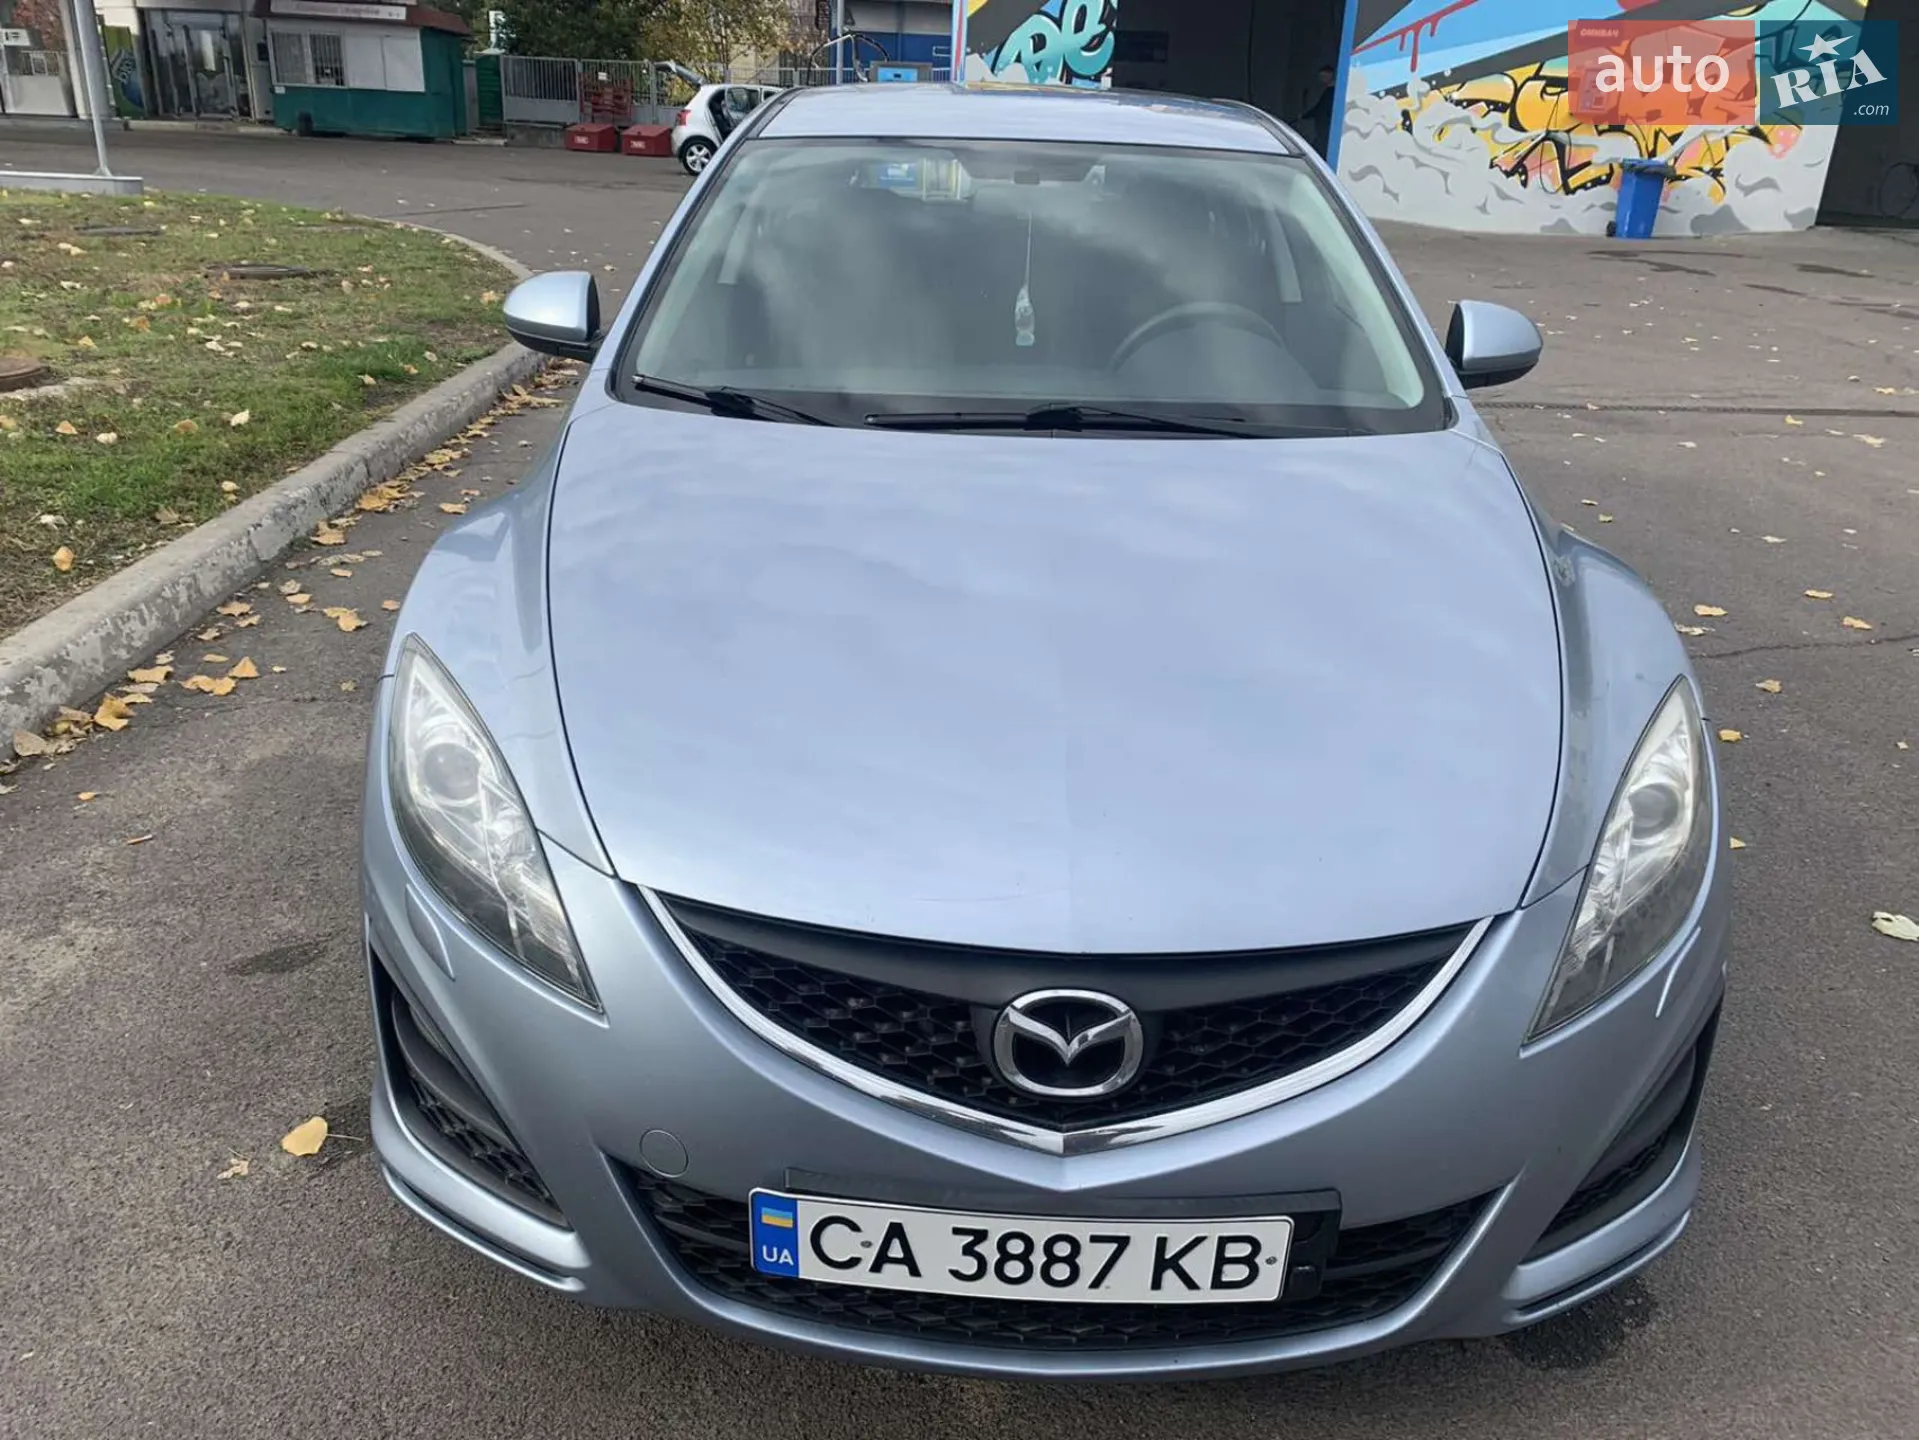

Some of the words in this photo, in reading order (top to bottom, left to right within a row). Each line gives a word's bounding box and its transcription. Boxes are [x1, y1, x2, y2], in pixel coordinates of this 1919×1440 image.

[762, 1245, 794, 1266] UA
[809, 1215, 922, 1278] CA
[948, 1226, 1131, 1290] 3887
[1150, 1235, 1262, 1291] KB
